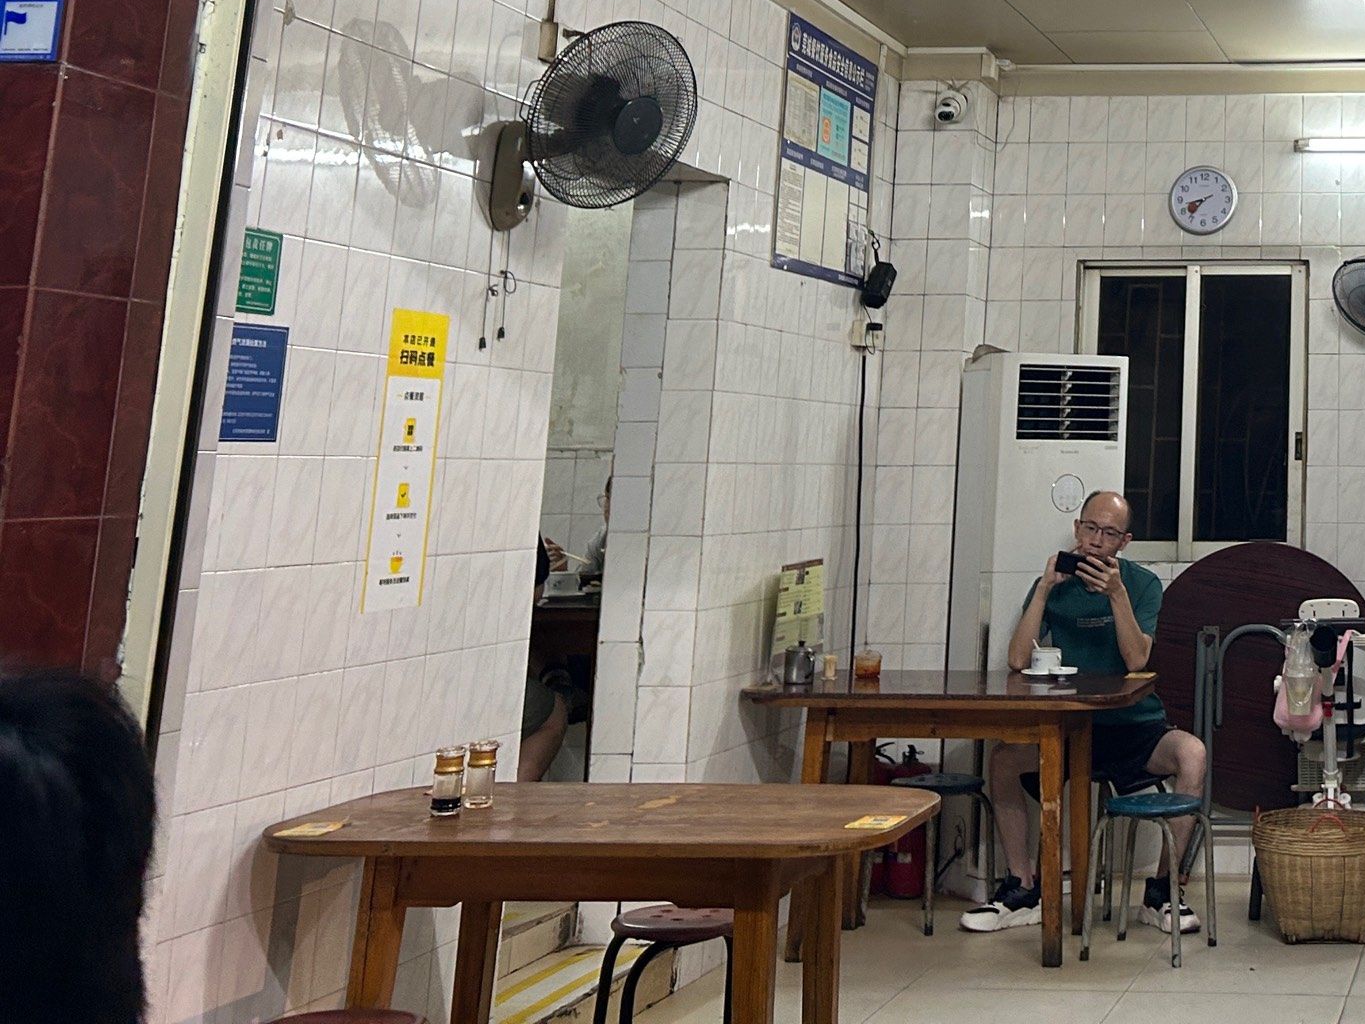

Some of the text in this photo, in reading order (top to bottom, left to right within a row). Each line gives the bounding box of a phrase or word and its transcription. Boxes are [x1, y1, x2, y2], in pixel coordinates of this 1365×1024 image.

[1189, 176, 1198, 184] 11
[1200, 172, 1210, 181] 12
[1214, 176, 1219, 184] 1
[1180, 185, 1190, 193] 10
[1221, 184, 1228, 192] 2
[1176, 195, 1184, 204] 9
[1224, 195, 1231, 204] 3
[1180, 207, 1187, 216] 8
[1220, 207, 1227, 215] 4
[1200, 218, 1207, 227] 6
[1211, 215, 1219, 224] 5
